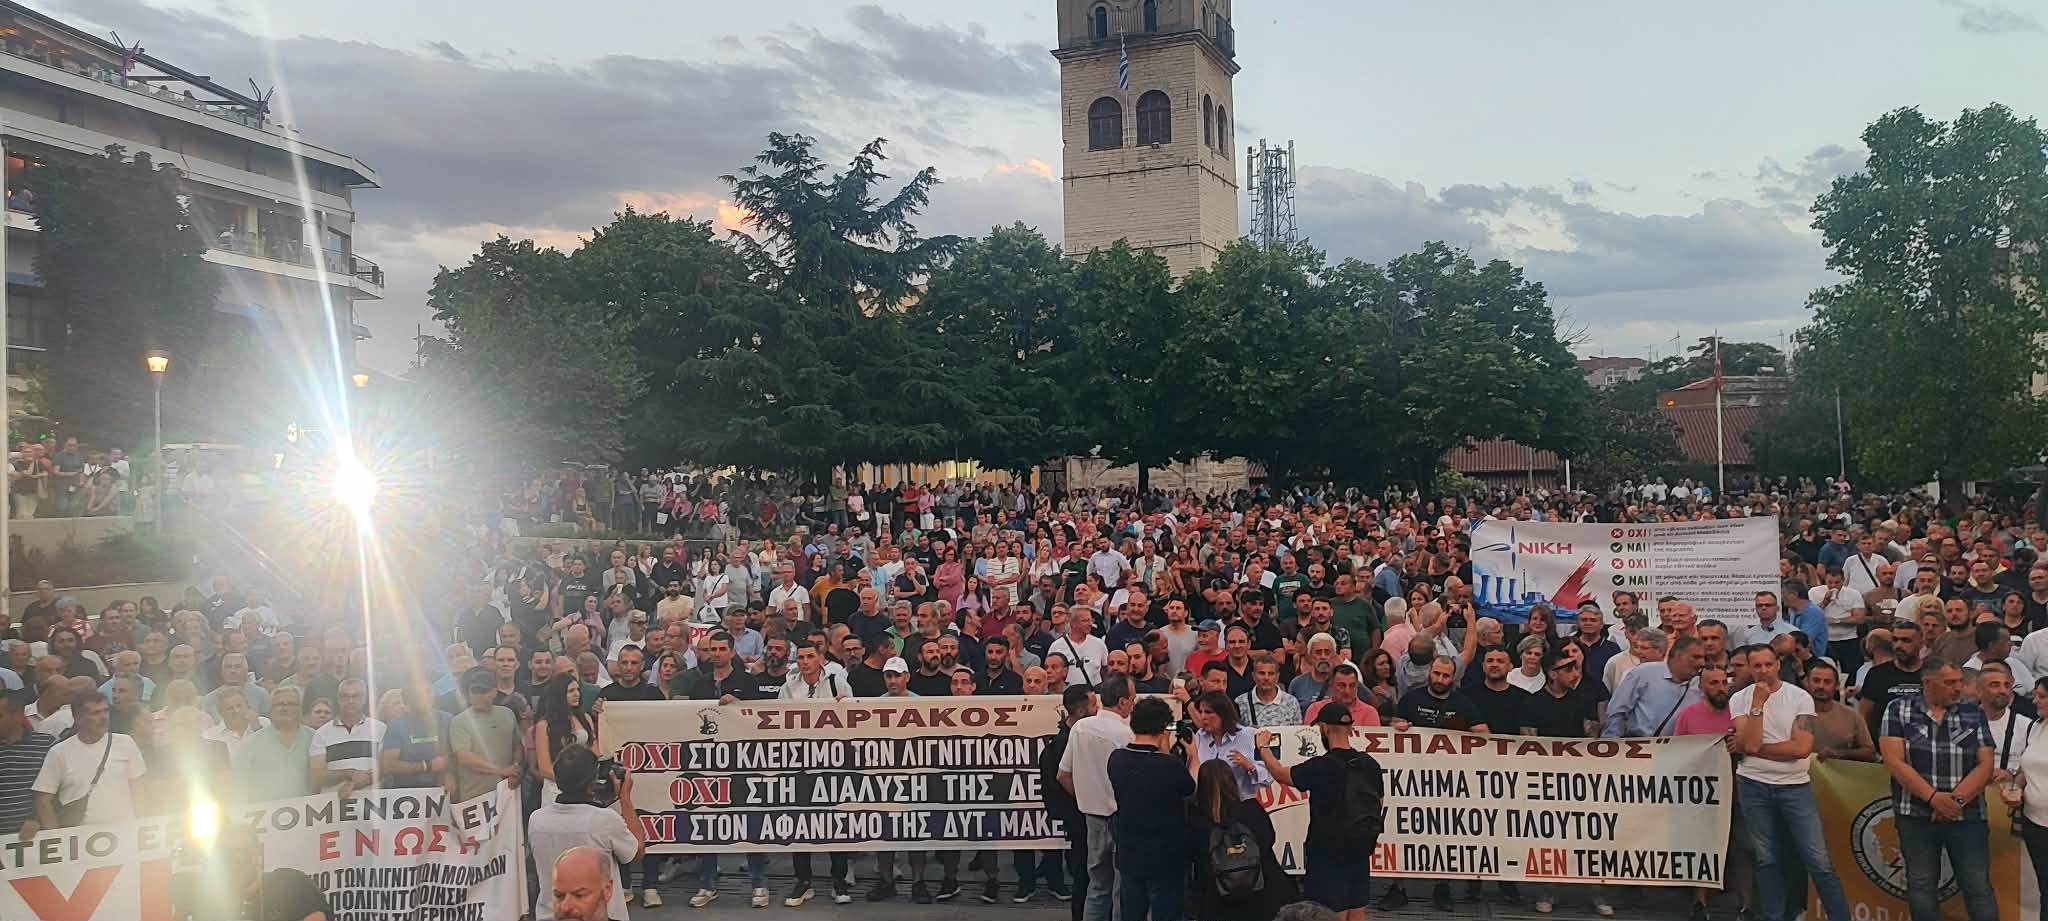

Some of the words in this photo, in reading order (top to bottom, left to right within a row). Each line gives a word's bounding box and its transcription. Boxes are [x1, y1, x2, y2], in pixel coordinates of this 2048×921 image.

[1518, 542, 1573, 555] ΝΙΚΗ
[1627, 542, 1646, 553] ΝΑΙ
[1628, 528, 1647, 538] ΟΧΙ
[1628, 558, 1647, 569] ΟΧΙ
[1628, 575, 1648, 585] ΝΑΙ
[741, 705, 1034, 730] "ΣΠΑΡΤΑΚΟΣ"
[621, 743, 681, 771] ΟΧΙ
[688, 743, 730, 769] ΣΤΟ
[736, 741, 845, 768] ΚΛΕΙΣΙΜΟ
[851, 740, 895, 767] ΤΩΝ
[901, 738, 1030, 767] ΛΙΓΝΙΤΙΚΩΝ
[1351, 730, 1671, 759] "ΣΠΑΡΤΑΚΟΣ"
[669, 778, 731, 805] ΟΧΙ
[746, 776, 796, 804] ΣΤΗ
[811, 775, 928, 803] ΔΙΑΛΥΣΗ
[942, 775, 994, 801] ΤΗΣ
[1008, 773, 1042, 801] ΔΕ
[1476, 770, 1519, 800] ΤΟΥ
[1526, 771, 1720, 805] ΞΕΠΟΥΛΗΜΑΤΟΣ
[639, 815, 676, 842] ΧΙ
[690, 814, 748, 841] ΣΤΟΝ
[760, 812, 883, 840] ΑΦΑΝΙΣΜΟ
[888, 812, 932, 838] ΤΗΣ
[943, 811, 993, 837] ΔΥΤ.
[1396, 806, 1499, 836] ΕΘΝΙΚΟΥ
[1506, 809, 1619, 840] ΠΛΟΥΤΟΥ
[0, 831, 119, 871] ΤΕΙΟ
[1370, 842, 1397, 870] ΕΝ
[1404, 844, 1499, 873] ΠΩΛΕΙΤΑΙ
[1525, 847, 1568, 875] ΔΕΝ
[1573, 849, 1720, 881] ΤΕΜΑΧΙΖΕΤΑΙ
[335, 867, 366, 889] ΤΩΝ
[441, 854, 506, 887] ΜΟΝΑΔΩΝ
